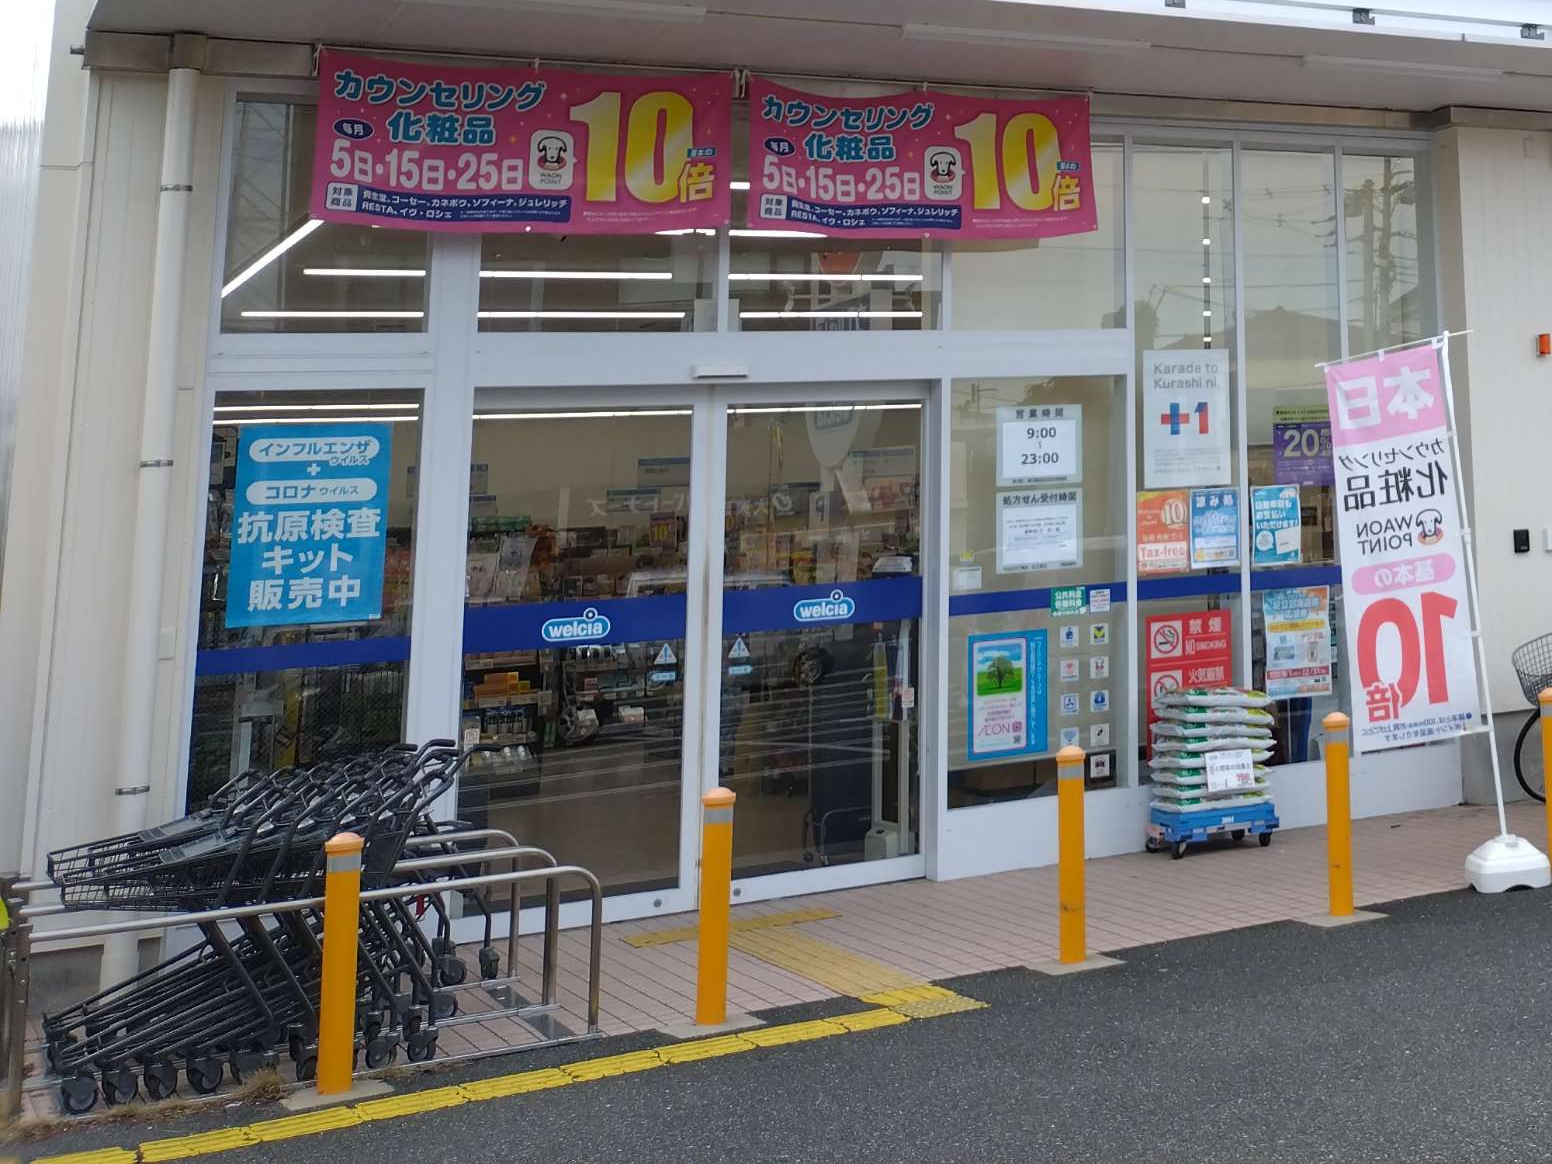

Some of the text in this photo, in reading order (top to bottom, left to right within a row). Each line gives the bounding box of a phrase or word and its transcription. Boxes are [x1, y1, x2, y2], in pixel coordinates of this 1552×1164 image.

[333, 67, 547, 112] カウンセリング
[386, 110, 497, 146] 化粧品
[761, 94, 934, 132] カウンセリング
[341, 122, 366, 137] 毎月
[570, 90, 694, 205] 10
[804, 133, 897, 163] 化粧品
[954, 111, 1062, 213] 10
[680, 162, 715, 203] 倍
[1053, 174, 1081, 212] 倍
[1153, 363, 1218, 375] Karada to
[1153, 377, 1202, 389] Kurashi
[259, 438, 371, 457] インフルエンザ
[1026, 427, 1057, 439] 9:00
[329, 455, 370, 467] ウイルス
[1021, 452, 1059, 464] 23:00
[265, 484, 359, 500] コロナ ウイルス
[237, 507, 382, 544] 抗原検査
[261, 543, 353, 575] キット
[247, 574, 361, 611] 販売中
[799, 589, 849, 620] welcia
[548, 608, 603, 638] welcia
[1185, 639, 1196, 655] NO
